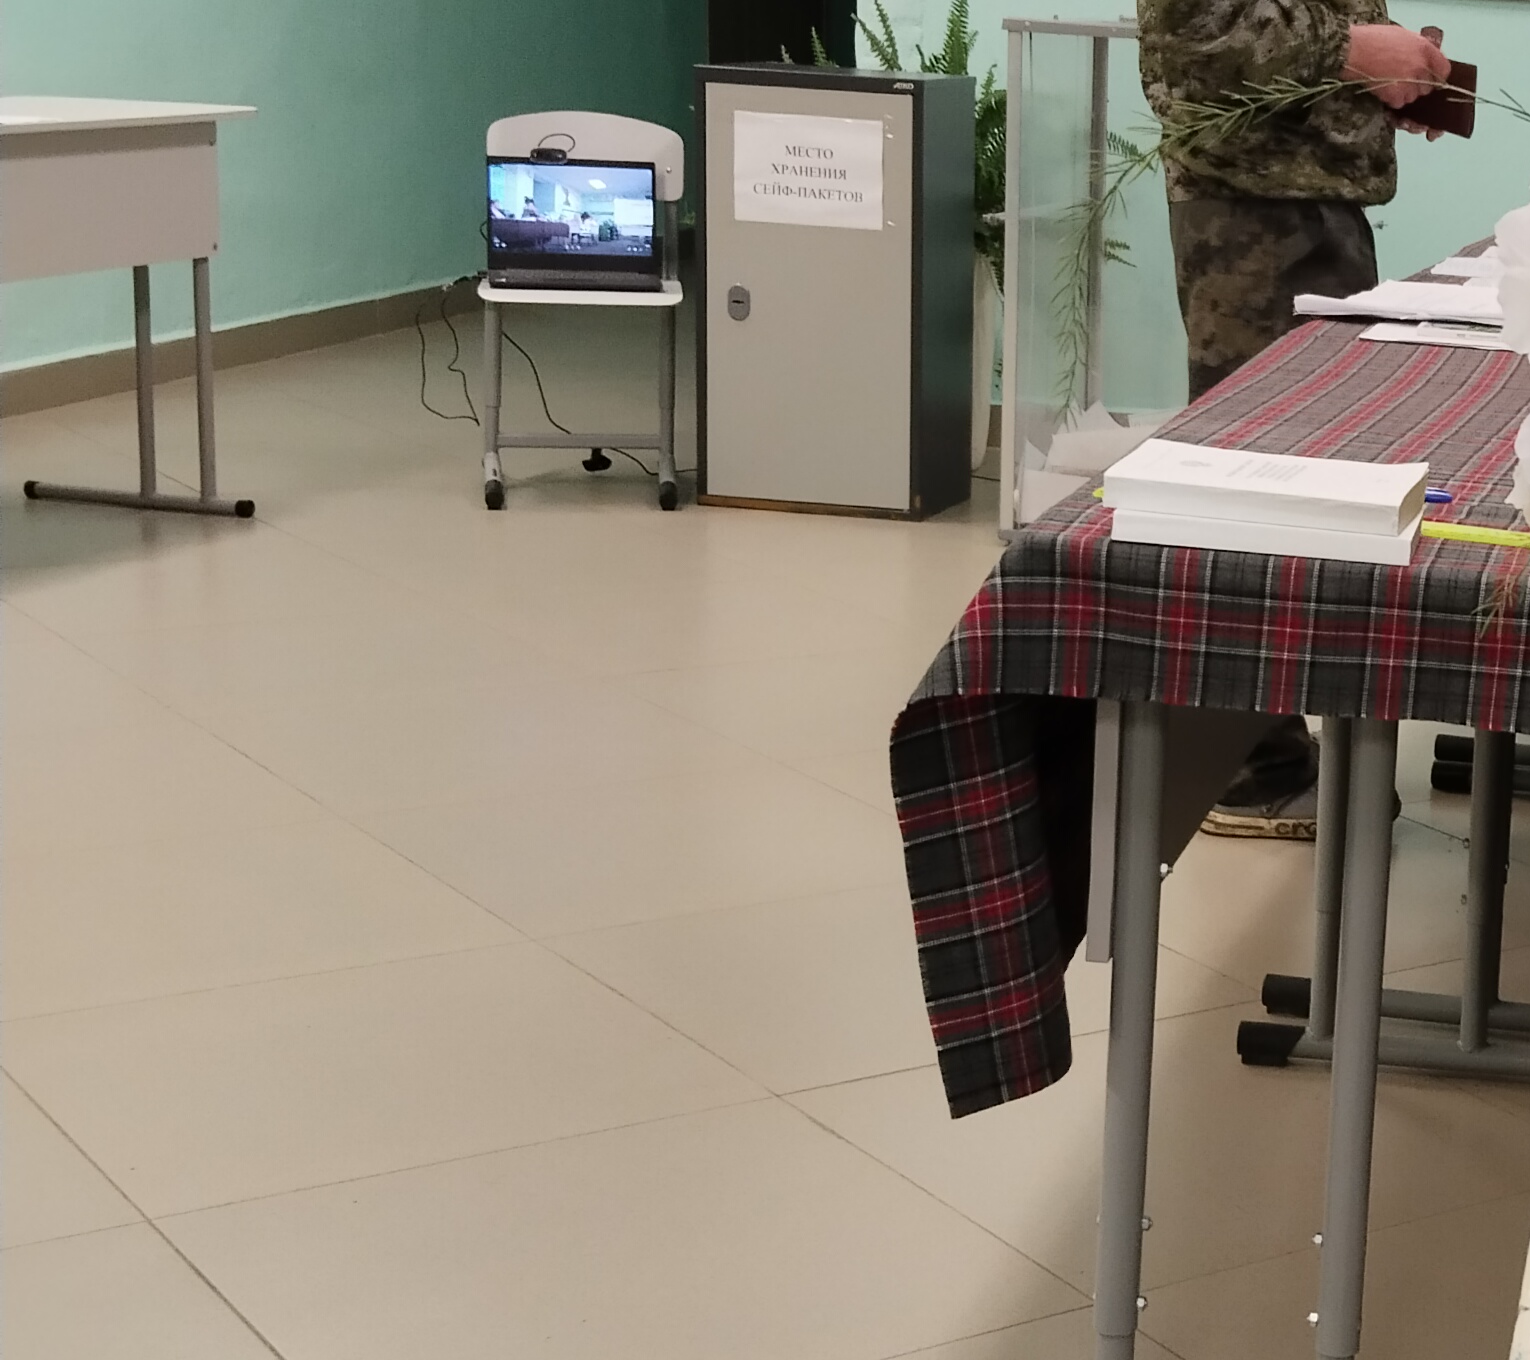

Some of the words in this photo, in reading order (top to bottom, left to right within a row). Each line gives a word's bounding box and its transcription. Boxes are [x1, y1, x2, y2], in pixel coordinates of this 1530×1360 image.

[784, 145, 834, 160] МЕСТО
[770, 162, 848, 181] ХРАНЕНИЯ
[752, 181, 864, 203] СЕЙФ-ПАКЕТОВ
